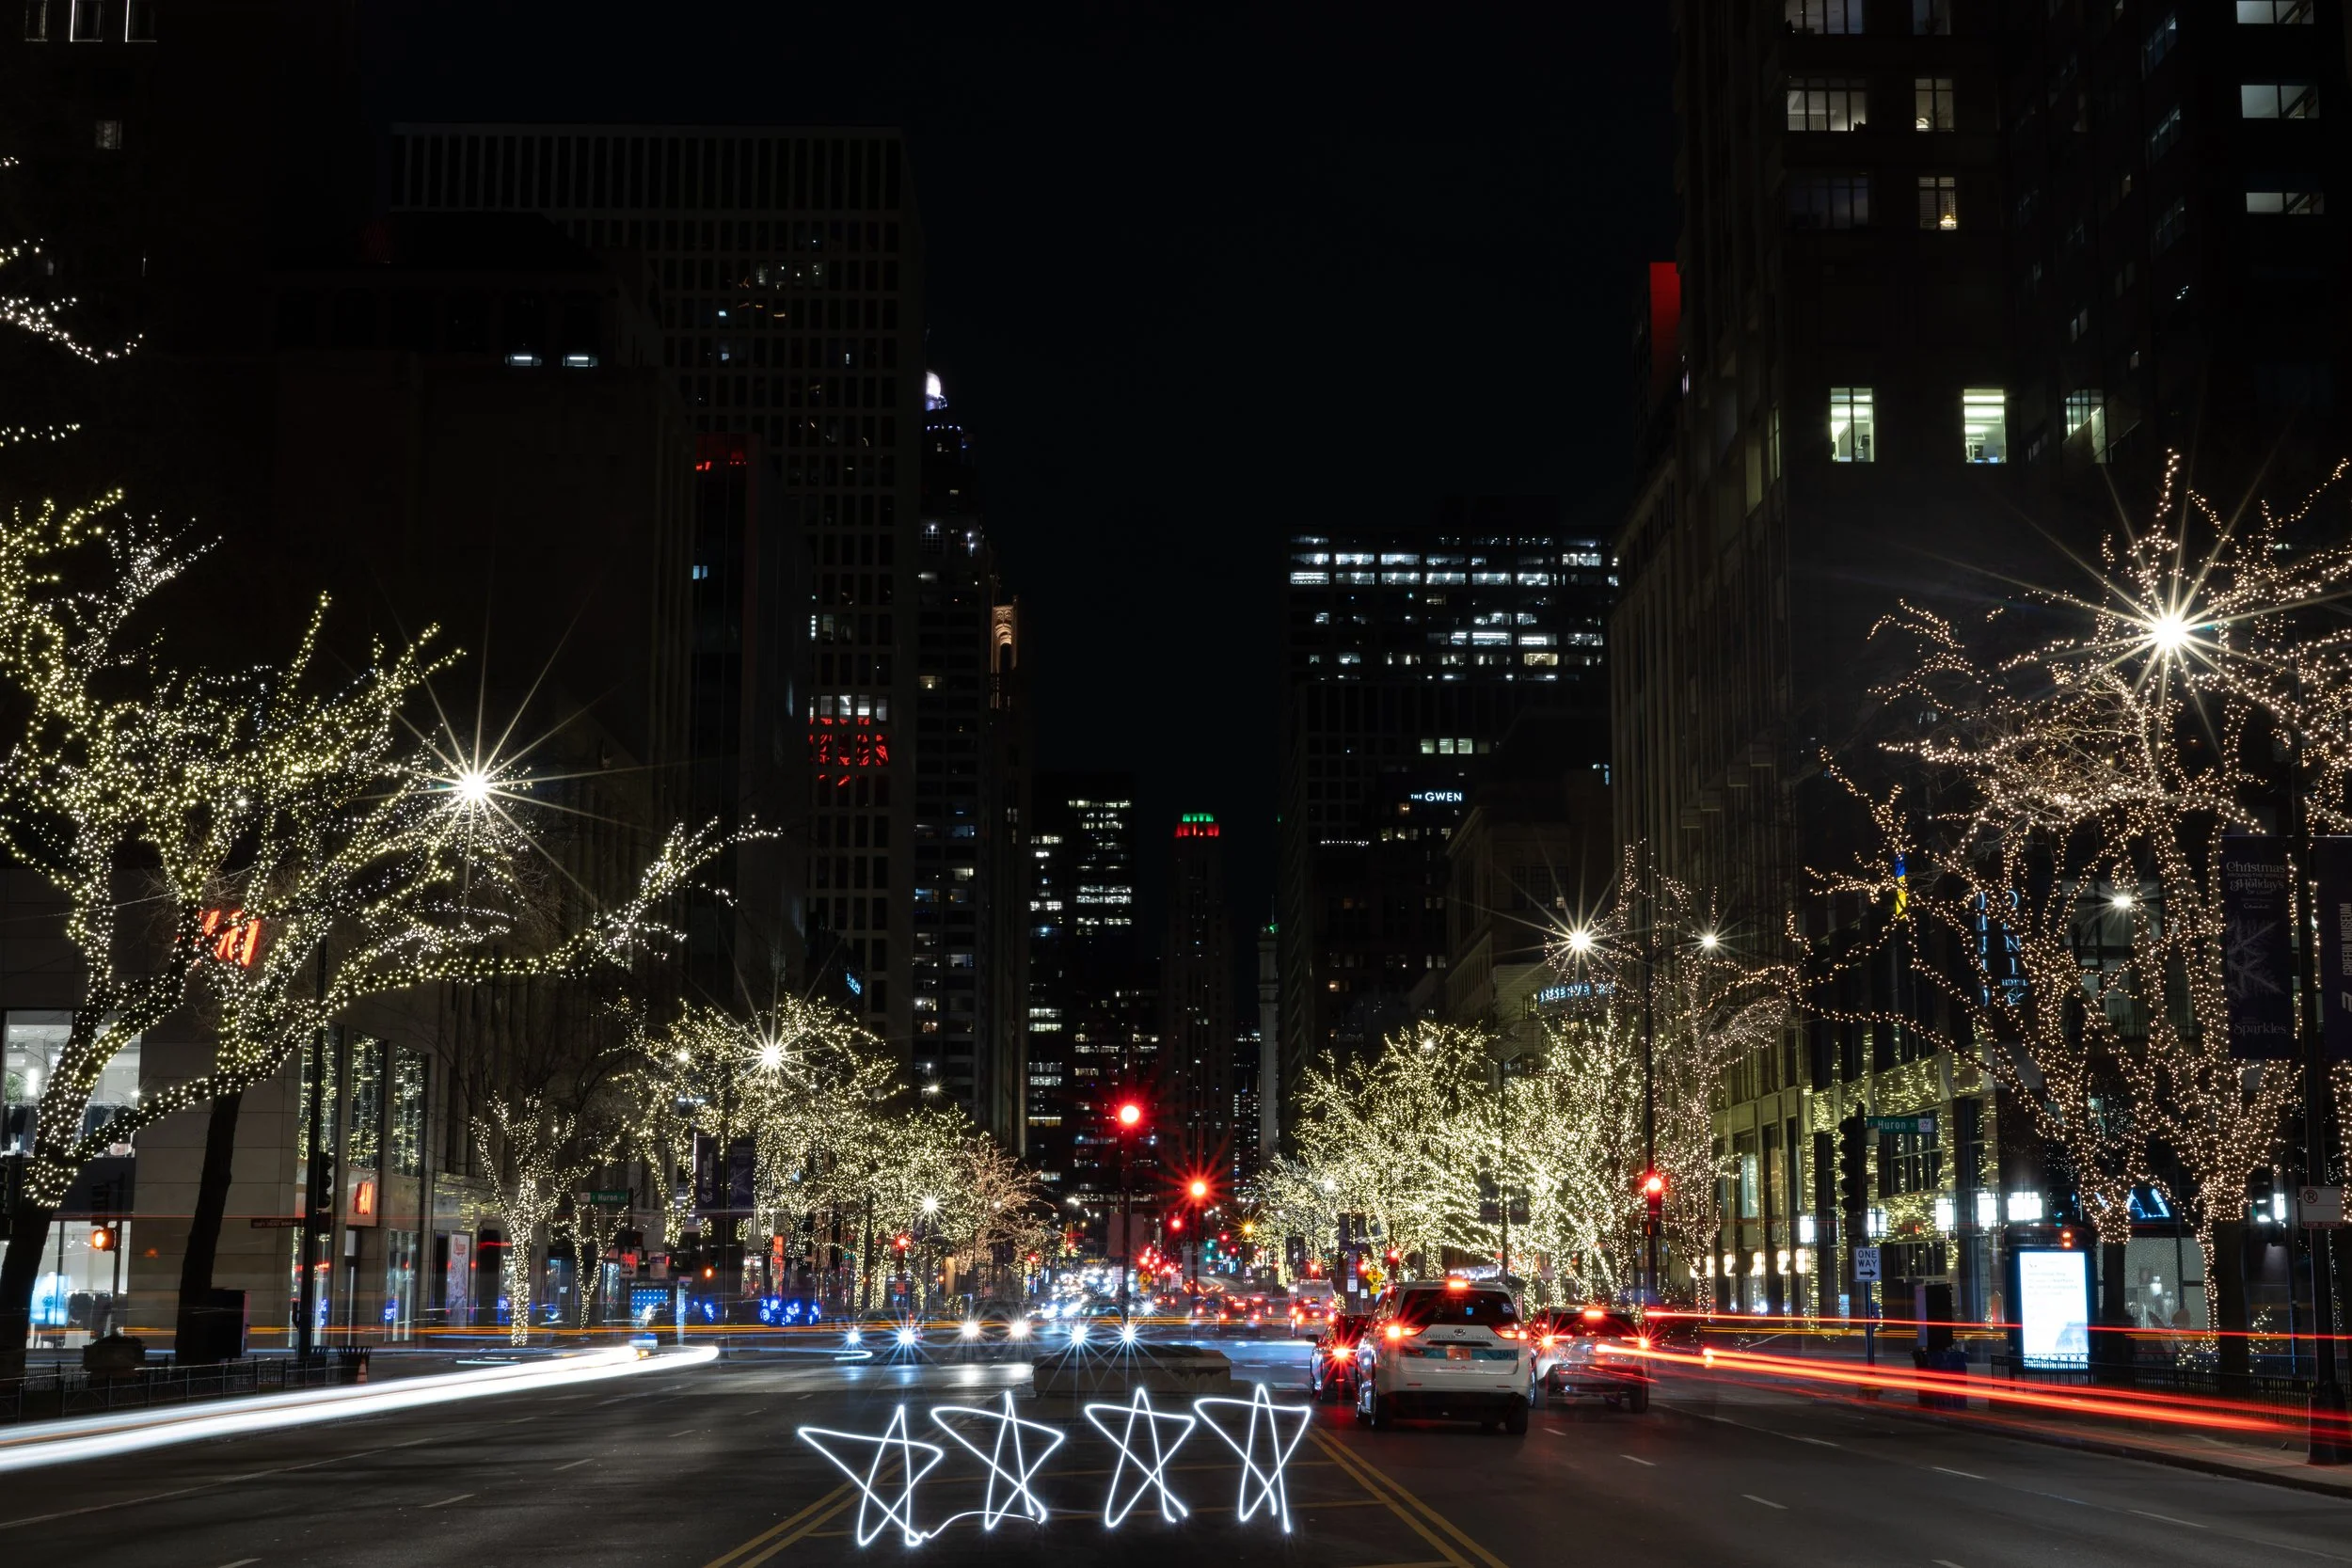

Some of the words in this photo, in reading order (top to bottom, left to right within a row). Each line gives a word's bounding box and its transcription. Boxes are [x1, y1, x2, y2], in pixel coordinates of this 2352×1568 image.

[1424, 791, 1462, 802] GWEN
[2226, 860, 2286, 874] Christmas
[2001, 978, 2029, 987] HOTL
[2233, 1022, 2287, 1037] Sparkles
[1877, 1119, 1906, 1130] Huron
[1858, 1250, 1877, 1259] ONE
[1858, 1259, 1877, 1267] WAY
